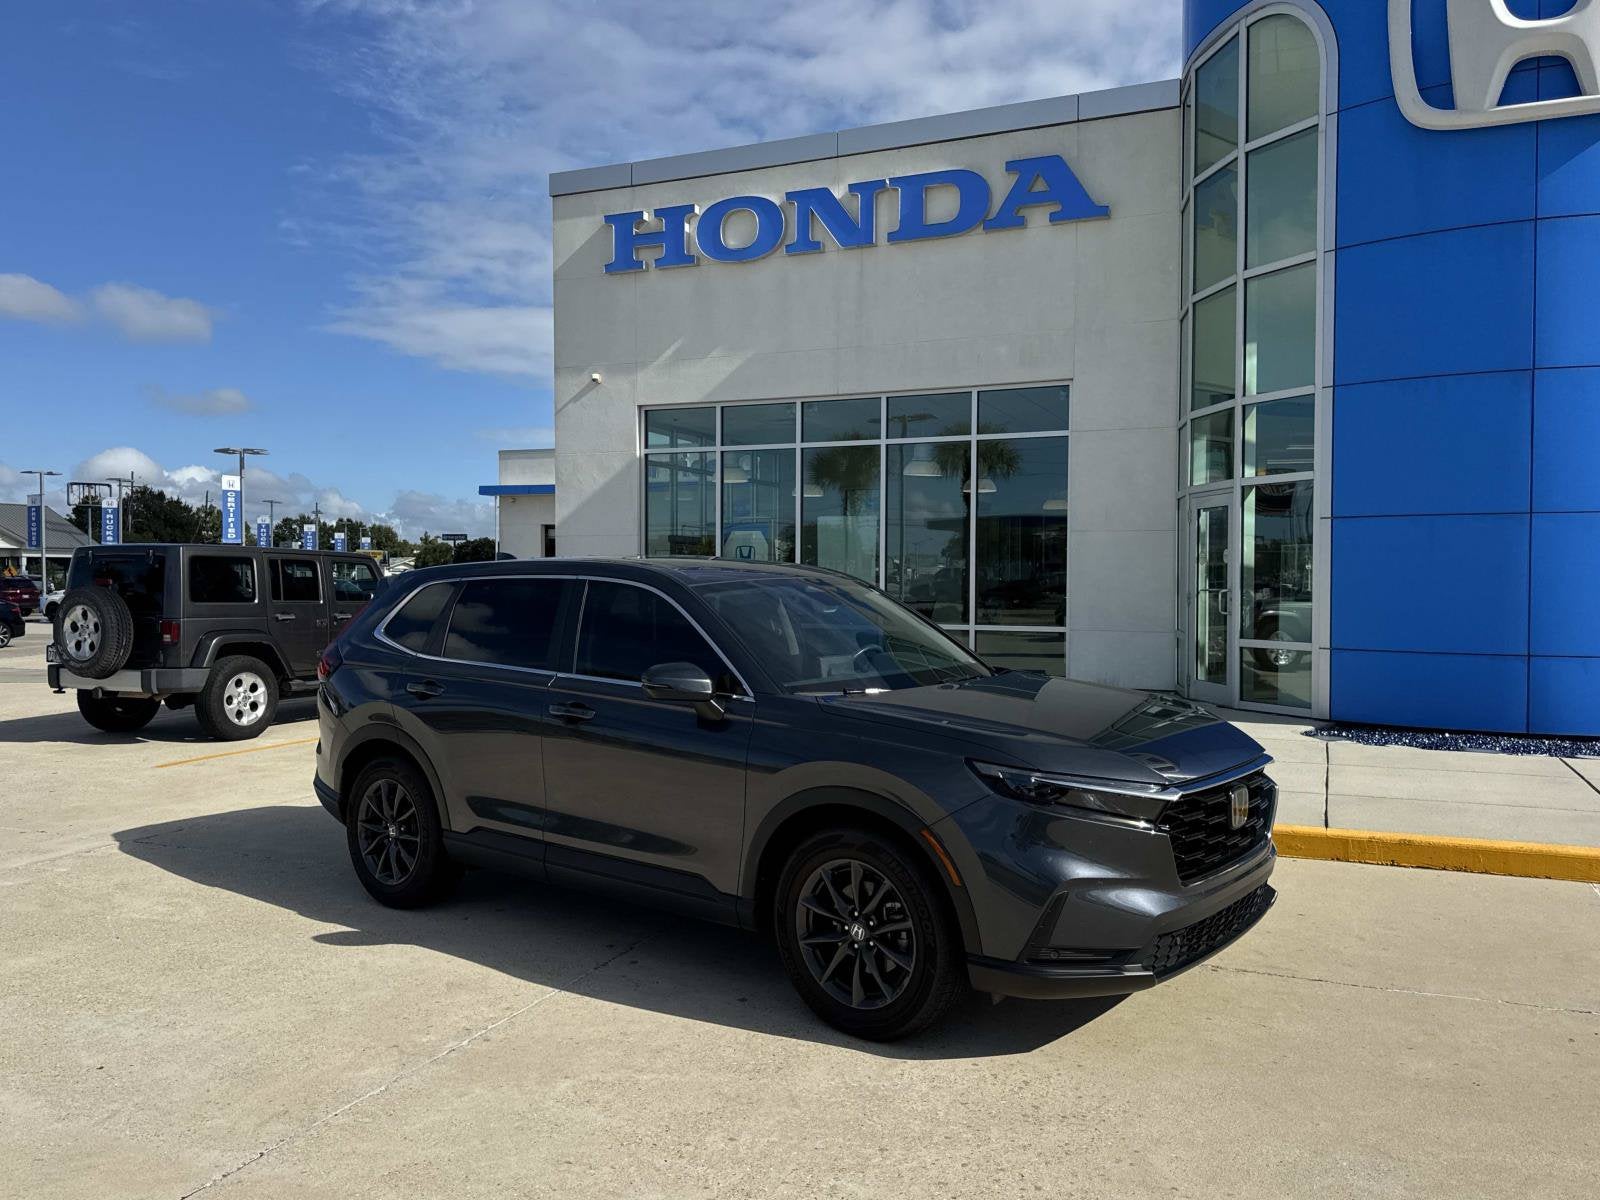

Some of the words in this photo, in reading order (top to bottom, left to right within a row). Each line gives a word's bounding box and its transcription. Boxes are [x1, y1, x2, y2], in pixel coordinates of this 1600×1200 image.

[603, 155, 1110, 274] HONDA
[106, 508, 114, 541] TRUCKS
[227, 491, 236, 539] CERTIFIED
